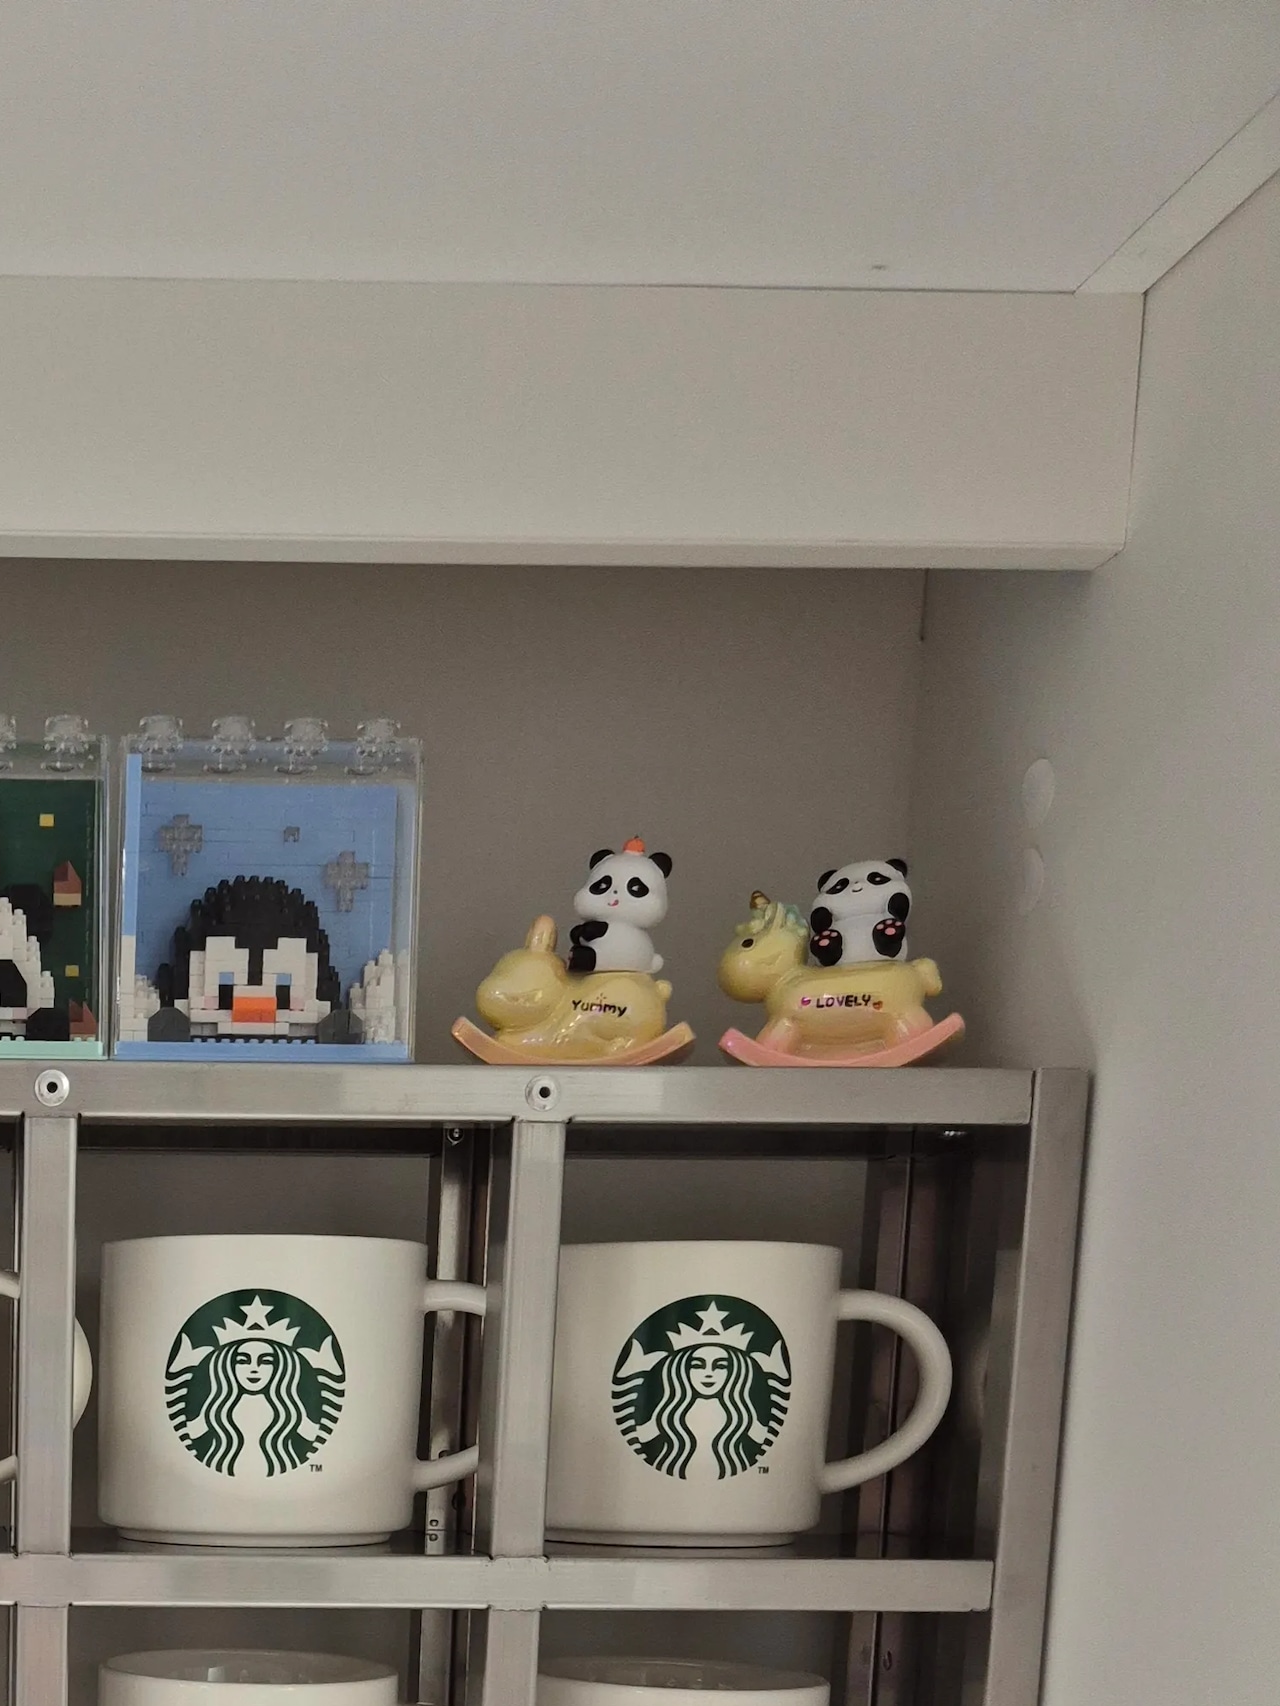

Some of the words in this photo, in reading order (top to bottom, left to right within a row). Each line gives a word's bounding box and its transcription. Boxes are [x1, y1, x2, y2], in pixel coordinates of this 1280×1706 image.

[816, 994, 871, 1008] LOVELY
[572, 999, 627, 1018] Yummy
[309, 1464, 323, 1472] TM
[757, 1466, 769, 1474] TM
